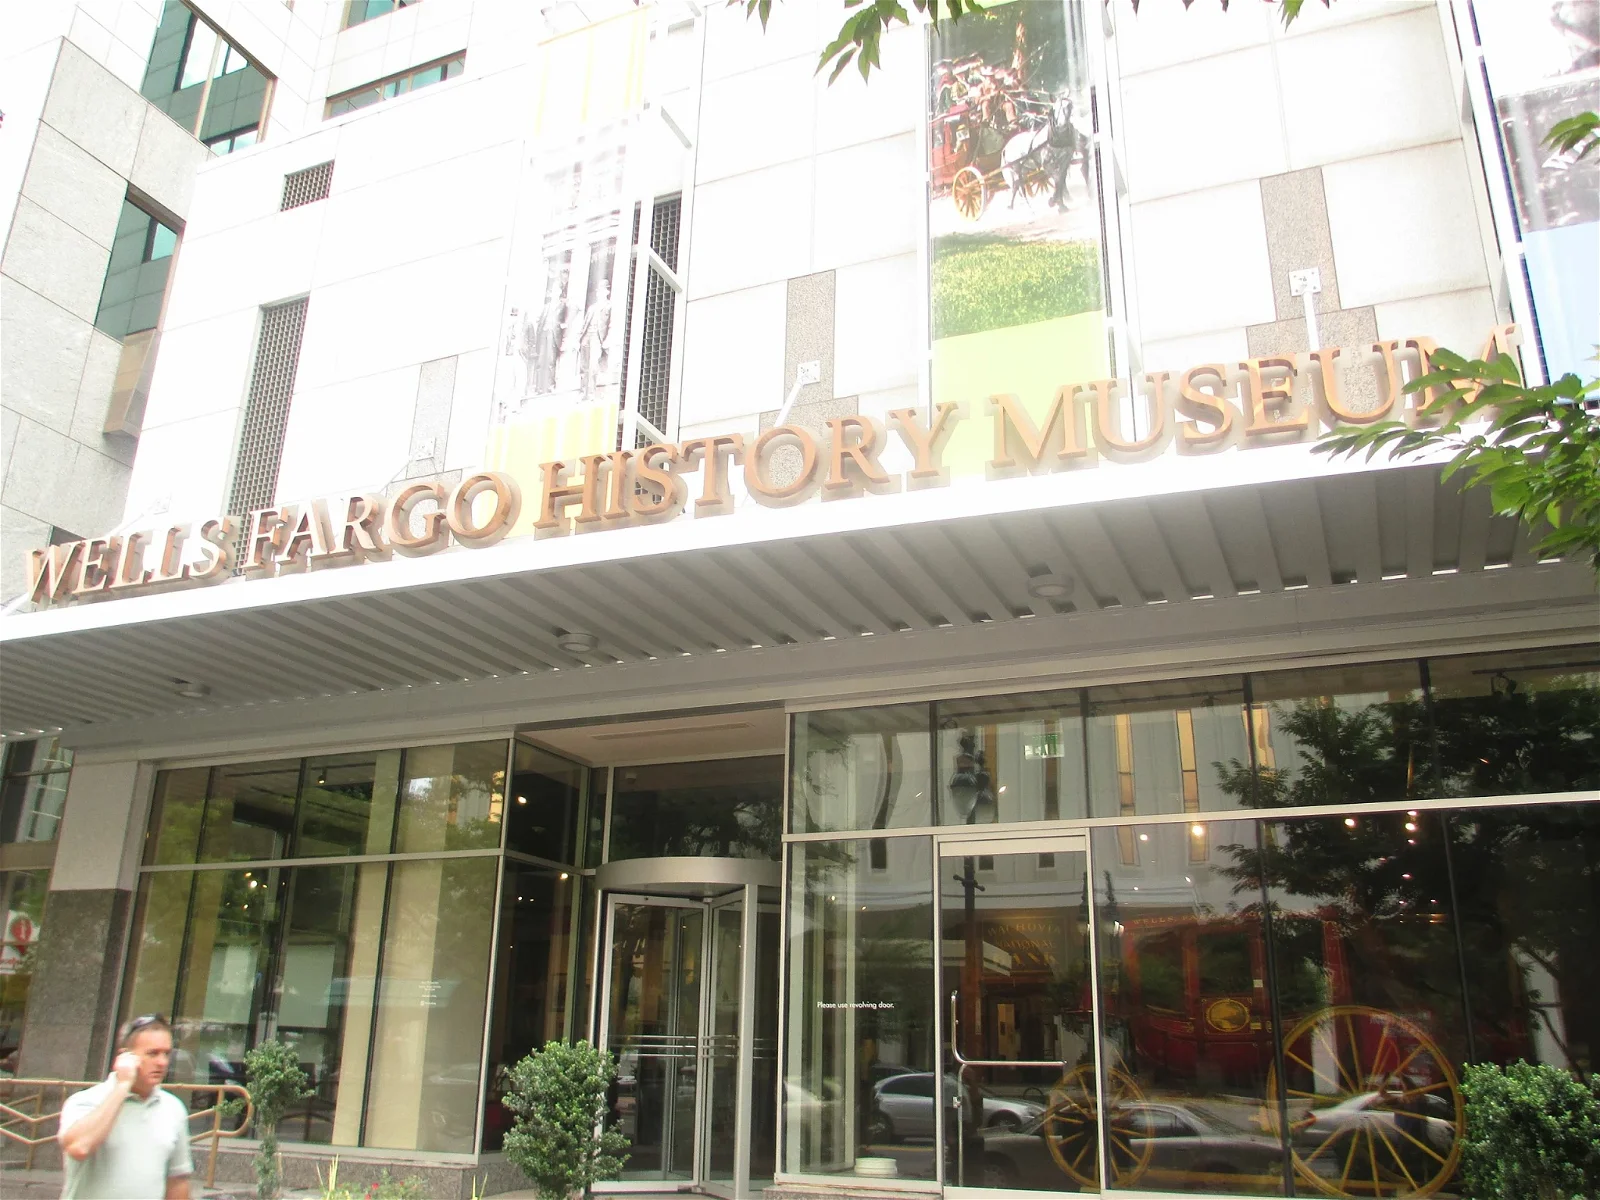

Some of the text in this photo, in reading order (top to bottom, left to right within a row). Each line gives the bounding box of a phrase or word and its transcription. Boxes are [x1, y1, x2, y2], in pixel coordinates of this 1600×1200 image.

[25, 516, 233, 605] WELLS
[240, 471, 512, 570] FARGO
[533, 402, 959, 529] HISTORY
[817, 1001, 836, 1009] Please
[850, 1001, 877, 1010] revolving
[878, 1001, 895, 1009] door.
